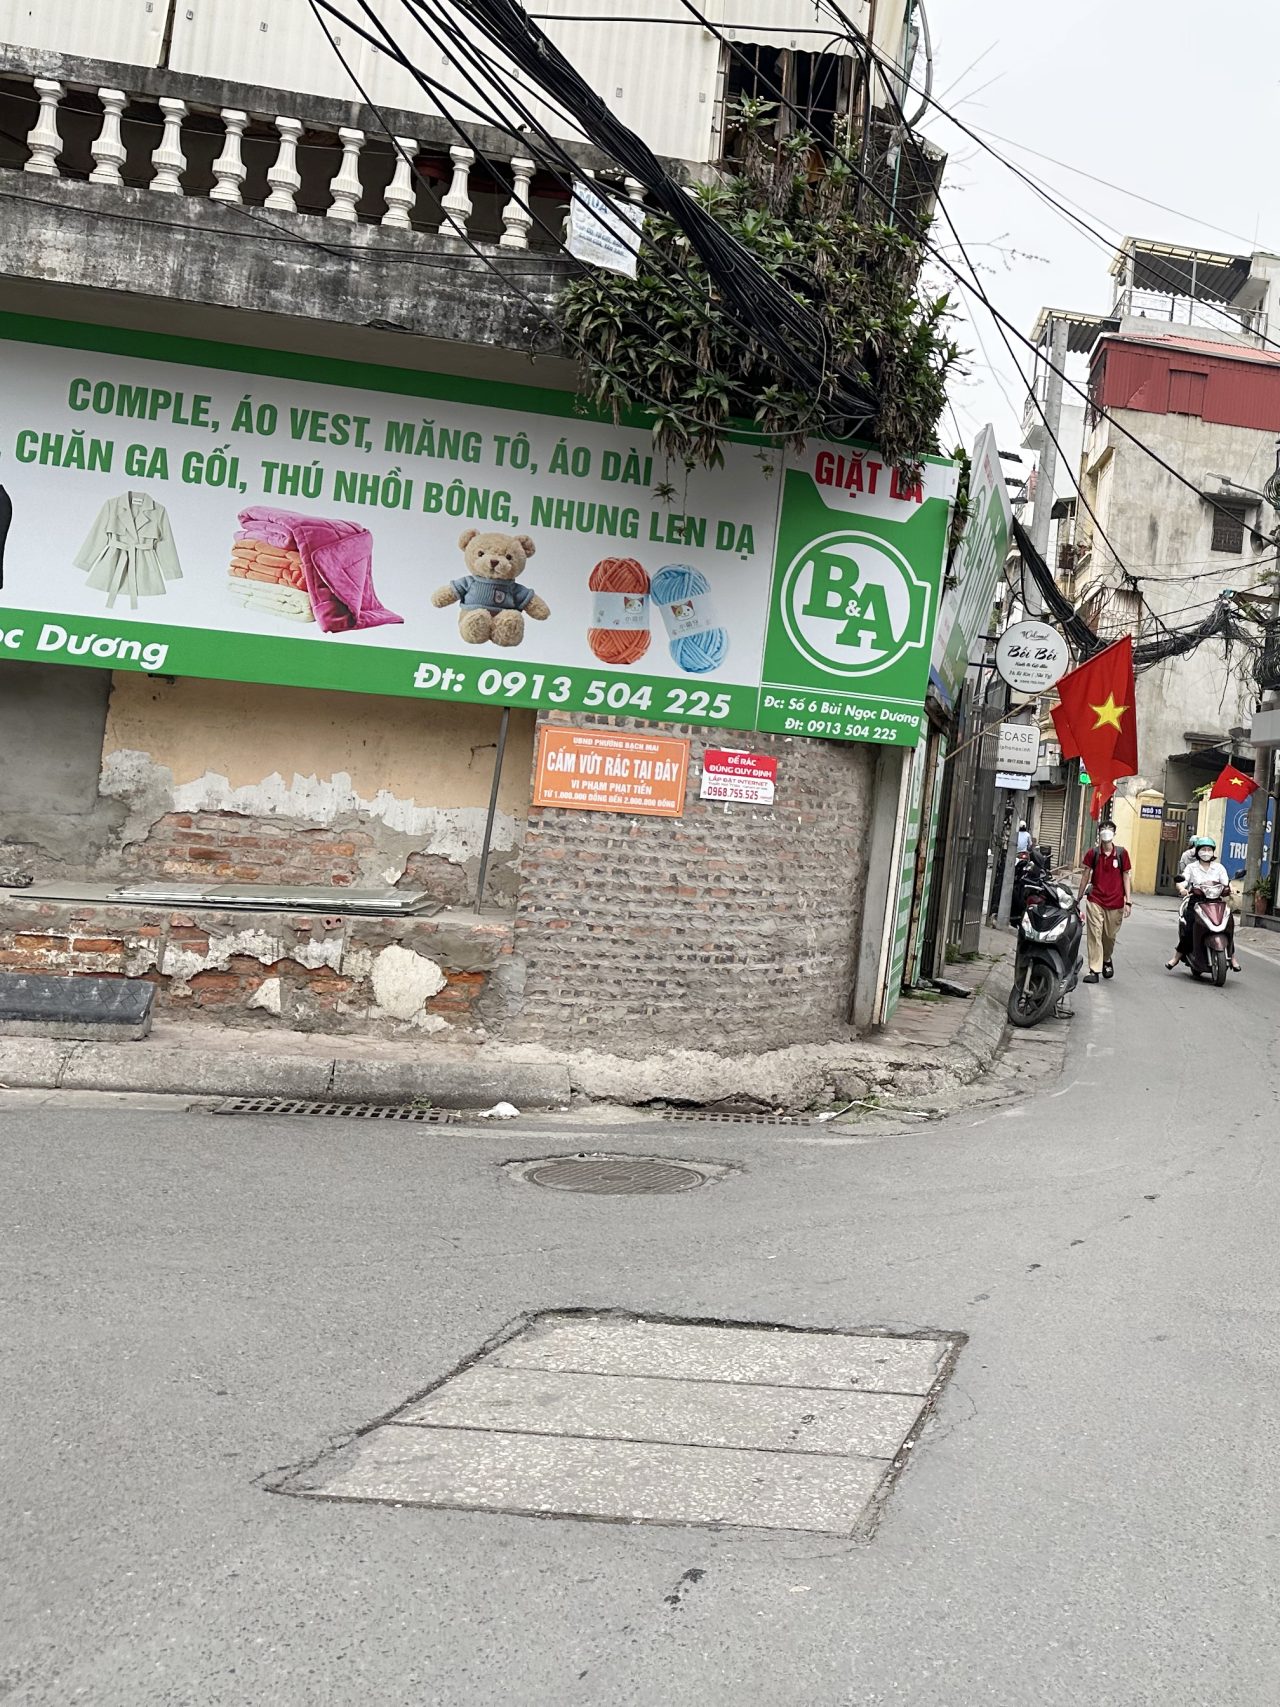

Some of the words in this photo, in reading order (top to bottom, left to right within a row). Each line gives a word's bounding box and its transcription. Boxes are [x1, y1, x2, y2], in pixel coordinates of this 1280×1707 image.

[68, 377, 220, 434] COMPLE,
[231, 394, 278, 436] ÁO
[290, 407, 373, 454] VEST,
[384, 418, 483, 464] MĂNG
[493, 432, 538, 475] TÔ,
[548, 437, 591, 478] ÁO
[601, 447, 653, 487] DÀI
[815, 450, 882, 499] GIẶT
[15, 428, 114, 473] CHĂN
[124, 443, 169, 481] GA
[181, 443, 248, 494] GỐI,
[261, 460, 324, 499] THÚ
[333, 466, 414, 511] NHỒI
[423, 478, 519, 528] BÔNG,
[530, 495, 640, 539] NHUNG
[649, 511, 708, 548] LEN
[715, 520, 755, 560] DẠ
[36, 623, 169, 671] Dương
[413, 662, 466, 692] Đt:
[477, 668, 573, 703] 0913
[582, 680, 653, 711] 504
[662, 688, 733, 719] 225
[764, 695, 785, 709] Đc:
[788, 697, 806, 711] Số
[808, 701, 817, 713] 6
[820, 702, 841, 716] Bùi
[844, 705, 877, 722] Ngọc
[880, 709, 920, 728] Dương
[572, 736, 593, 746] UBND
[645, 744, 660, 752] MAI
[784, 717, 804, 731] Đt:
[807, 719, 842, 735] 0913
[844, 724, 870, 739] 504
[872, 728, 898, 741] 225
[547, 746, 576, 773] CẤM
[580, 751, 602, 776] VỨT
[604, 754, 631, 778] RÁC
[633, 759, 653, 784] TẠI
[654, 759, 679, 782] ĐÂY
[709, 763, 734, 774] ĐÚNG
[734, 767, 753, 775] QUY
[752, 769, 772, 778] ĐỊNH
[740, 757, 757, 766] RÁC
[571, 779, 580, 790] VI
[581, 780, 607, 794] PHẠM
[609, 782, 632, 797] PHẠT
[737, 778, 768, 787] INTERNET
